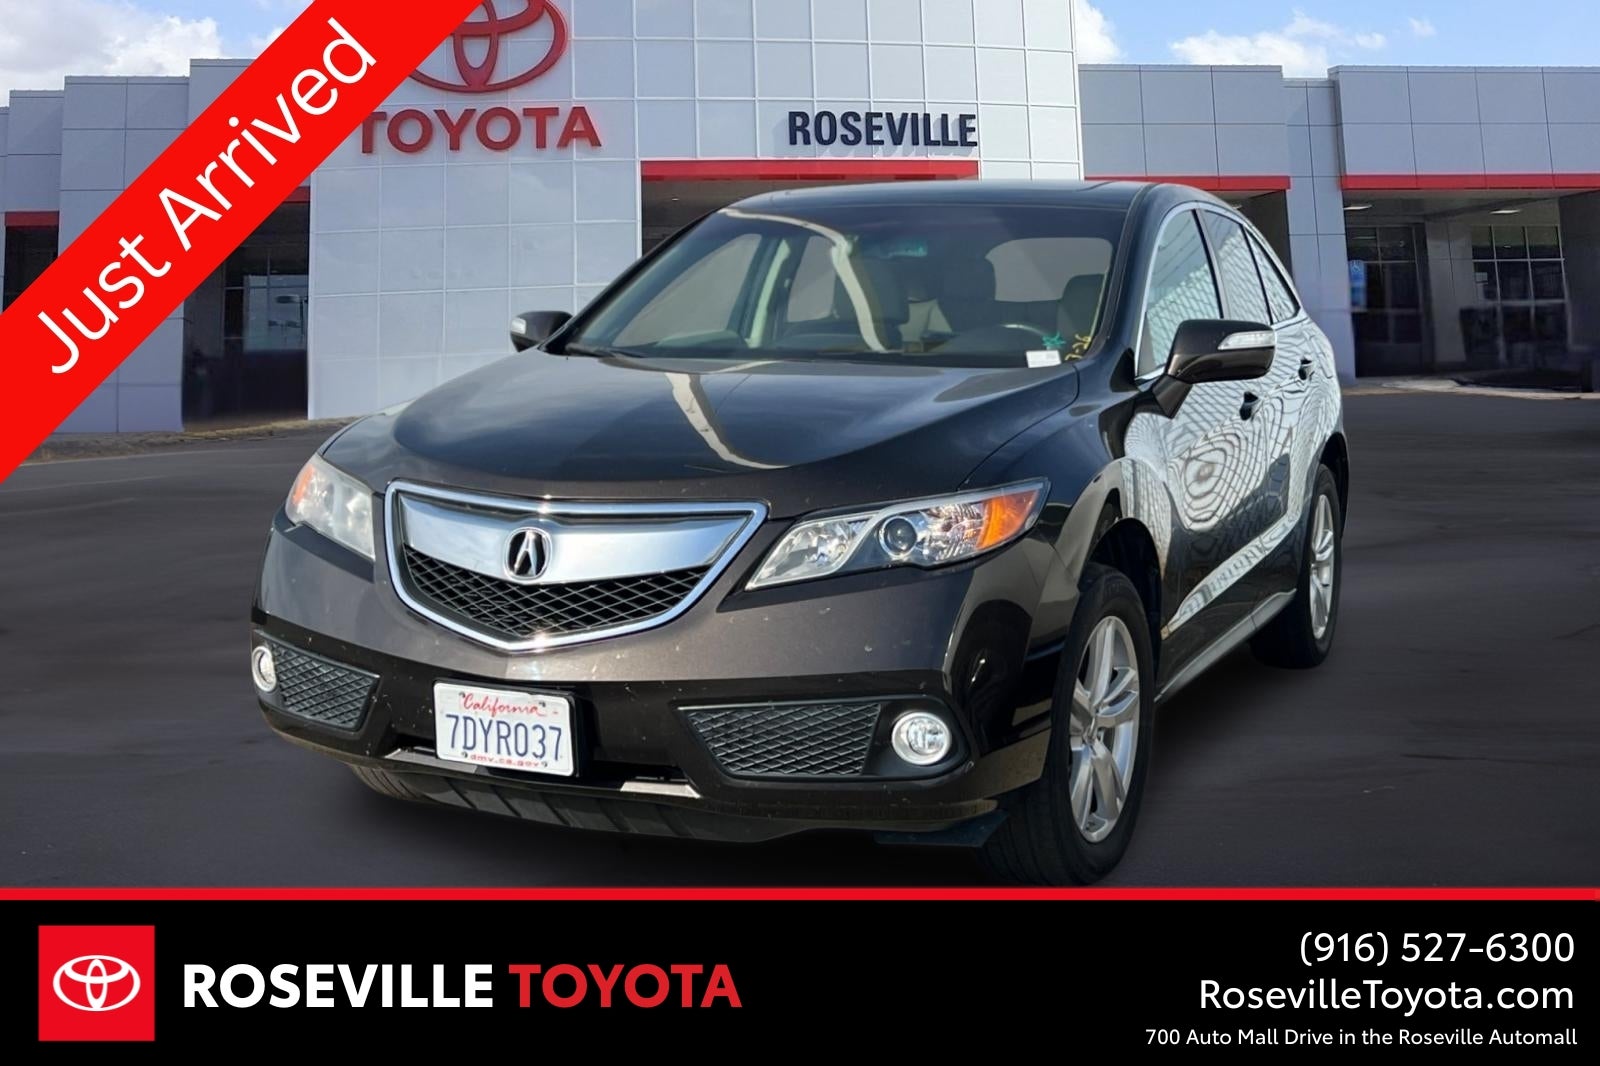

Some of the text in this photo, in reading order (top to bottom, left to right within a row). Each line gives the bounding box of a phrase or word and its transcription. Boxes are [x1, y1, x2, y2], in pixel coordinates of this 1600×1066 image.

[361, 106, 602, 154] TOYOTA
[788, 110, 978, 147] ROSEVILLE
[463, 692, 547, 718] California
[446, 713, 563, 761] 7DYR037
[470, 754, 539, 768] dmv.ca.gov
